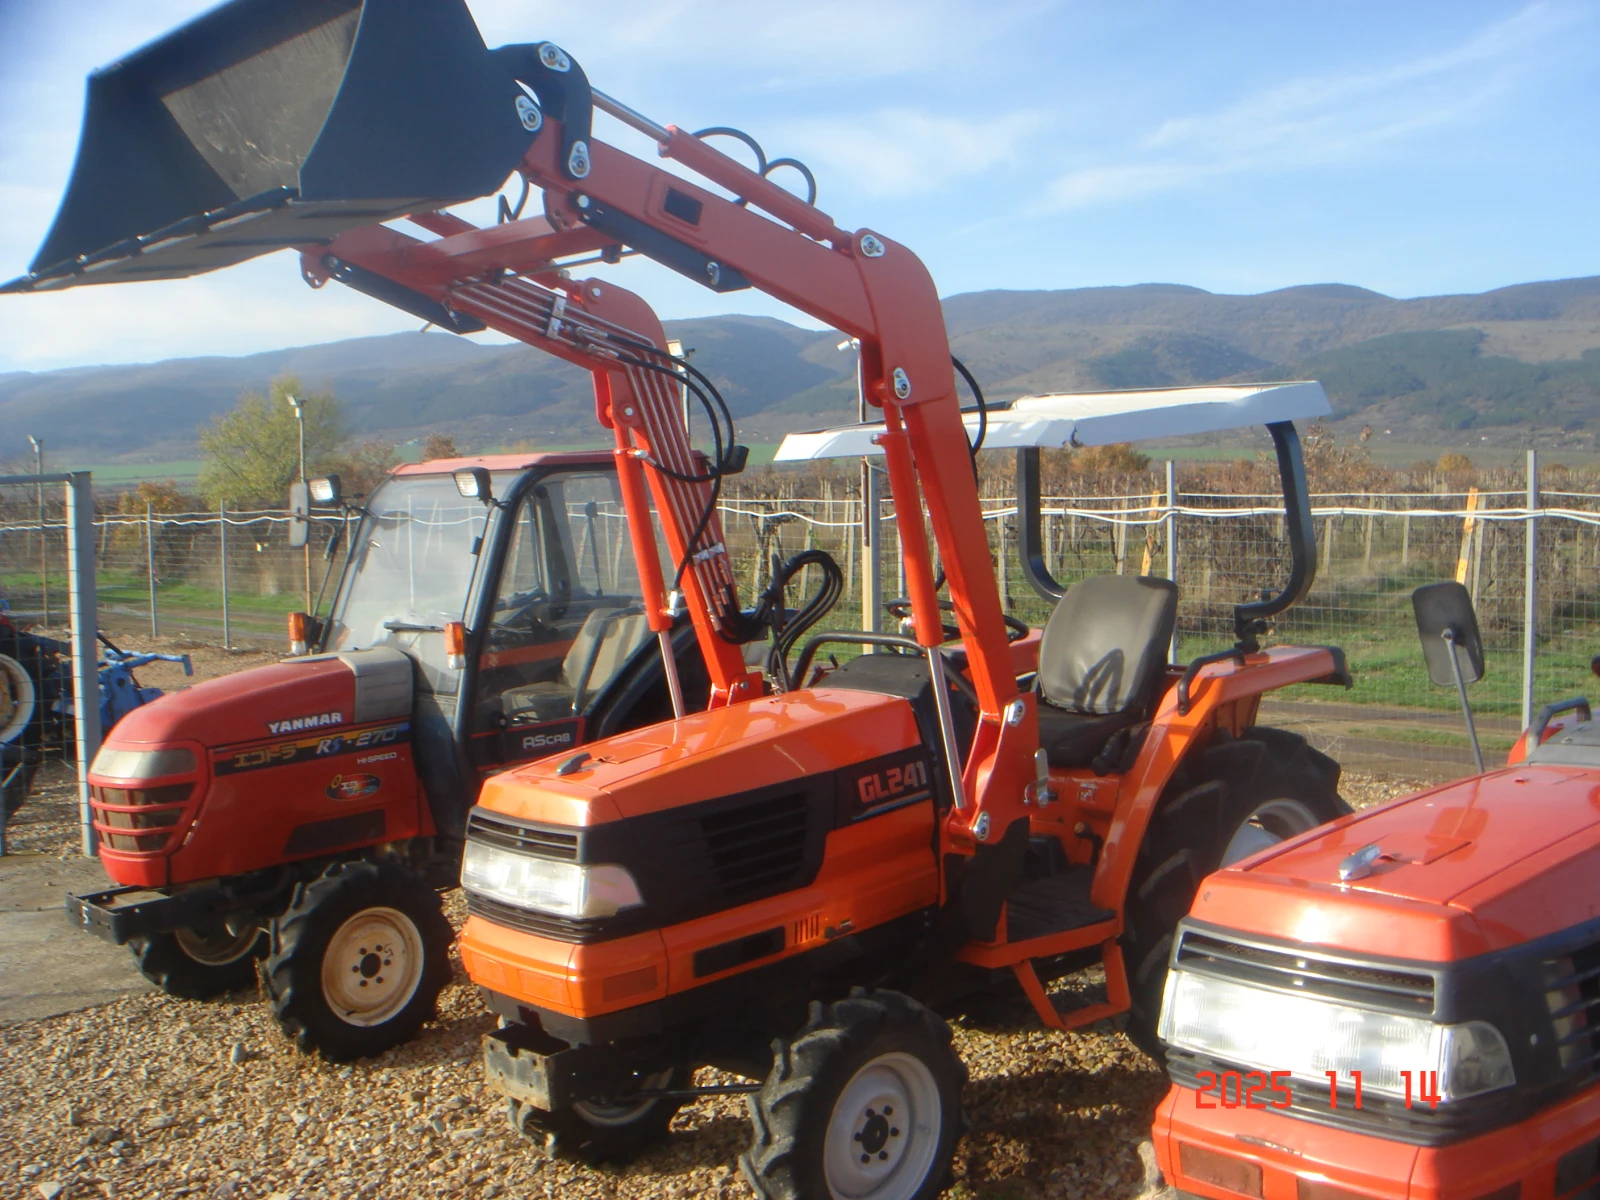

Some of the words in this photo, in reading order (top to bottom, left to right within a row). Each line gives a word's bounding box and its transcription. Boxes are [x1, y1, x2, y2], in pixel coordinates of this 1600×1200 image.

[268, 712, 342, 734] YANMAR
[234, 744, 297, 768] エコトラ
[857, 760, 927, 803] GL241
